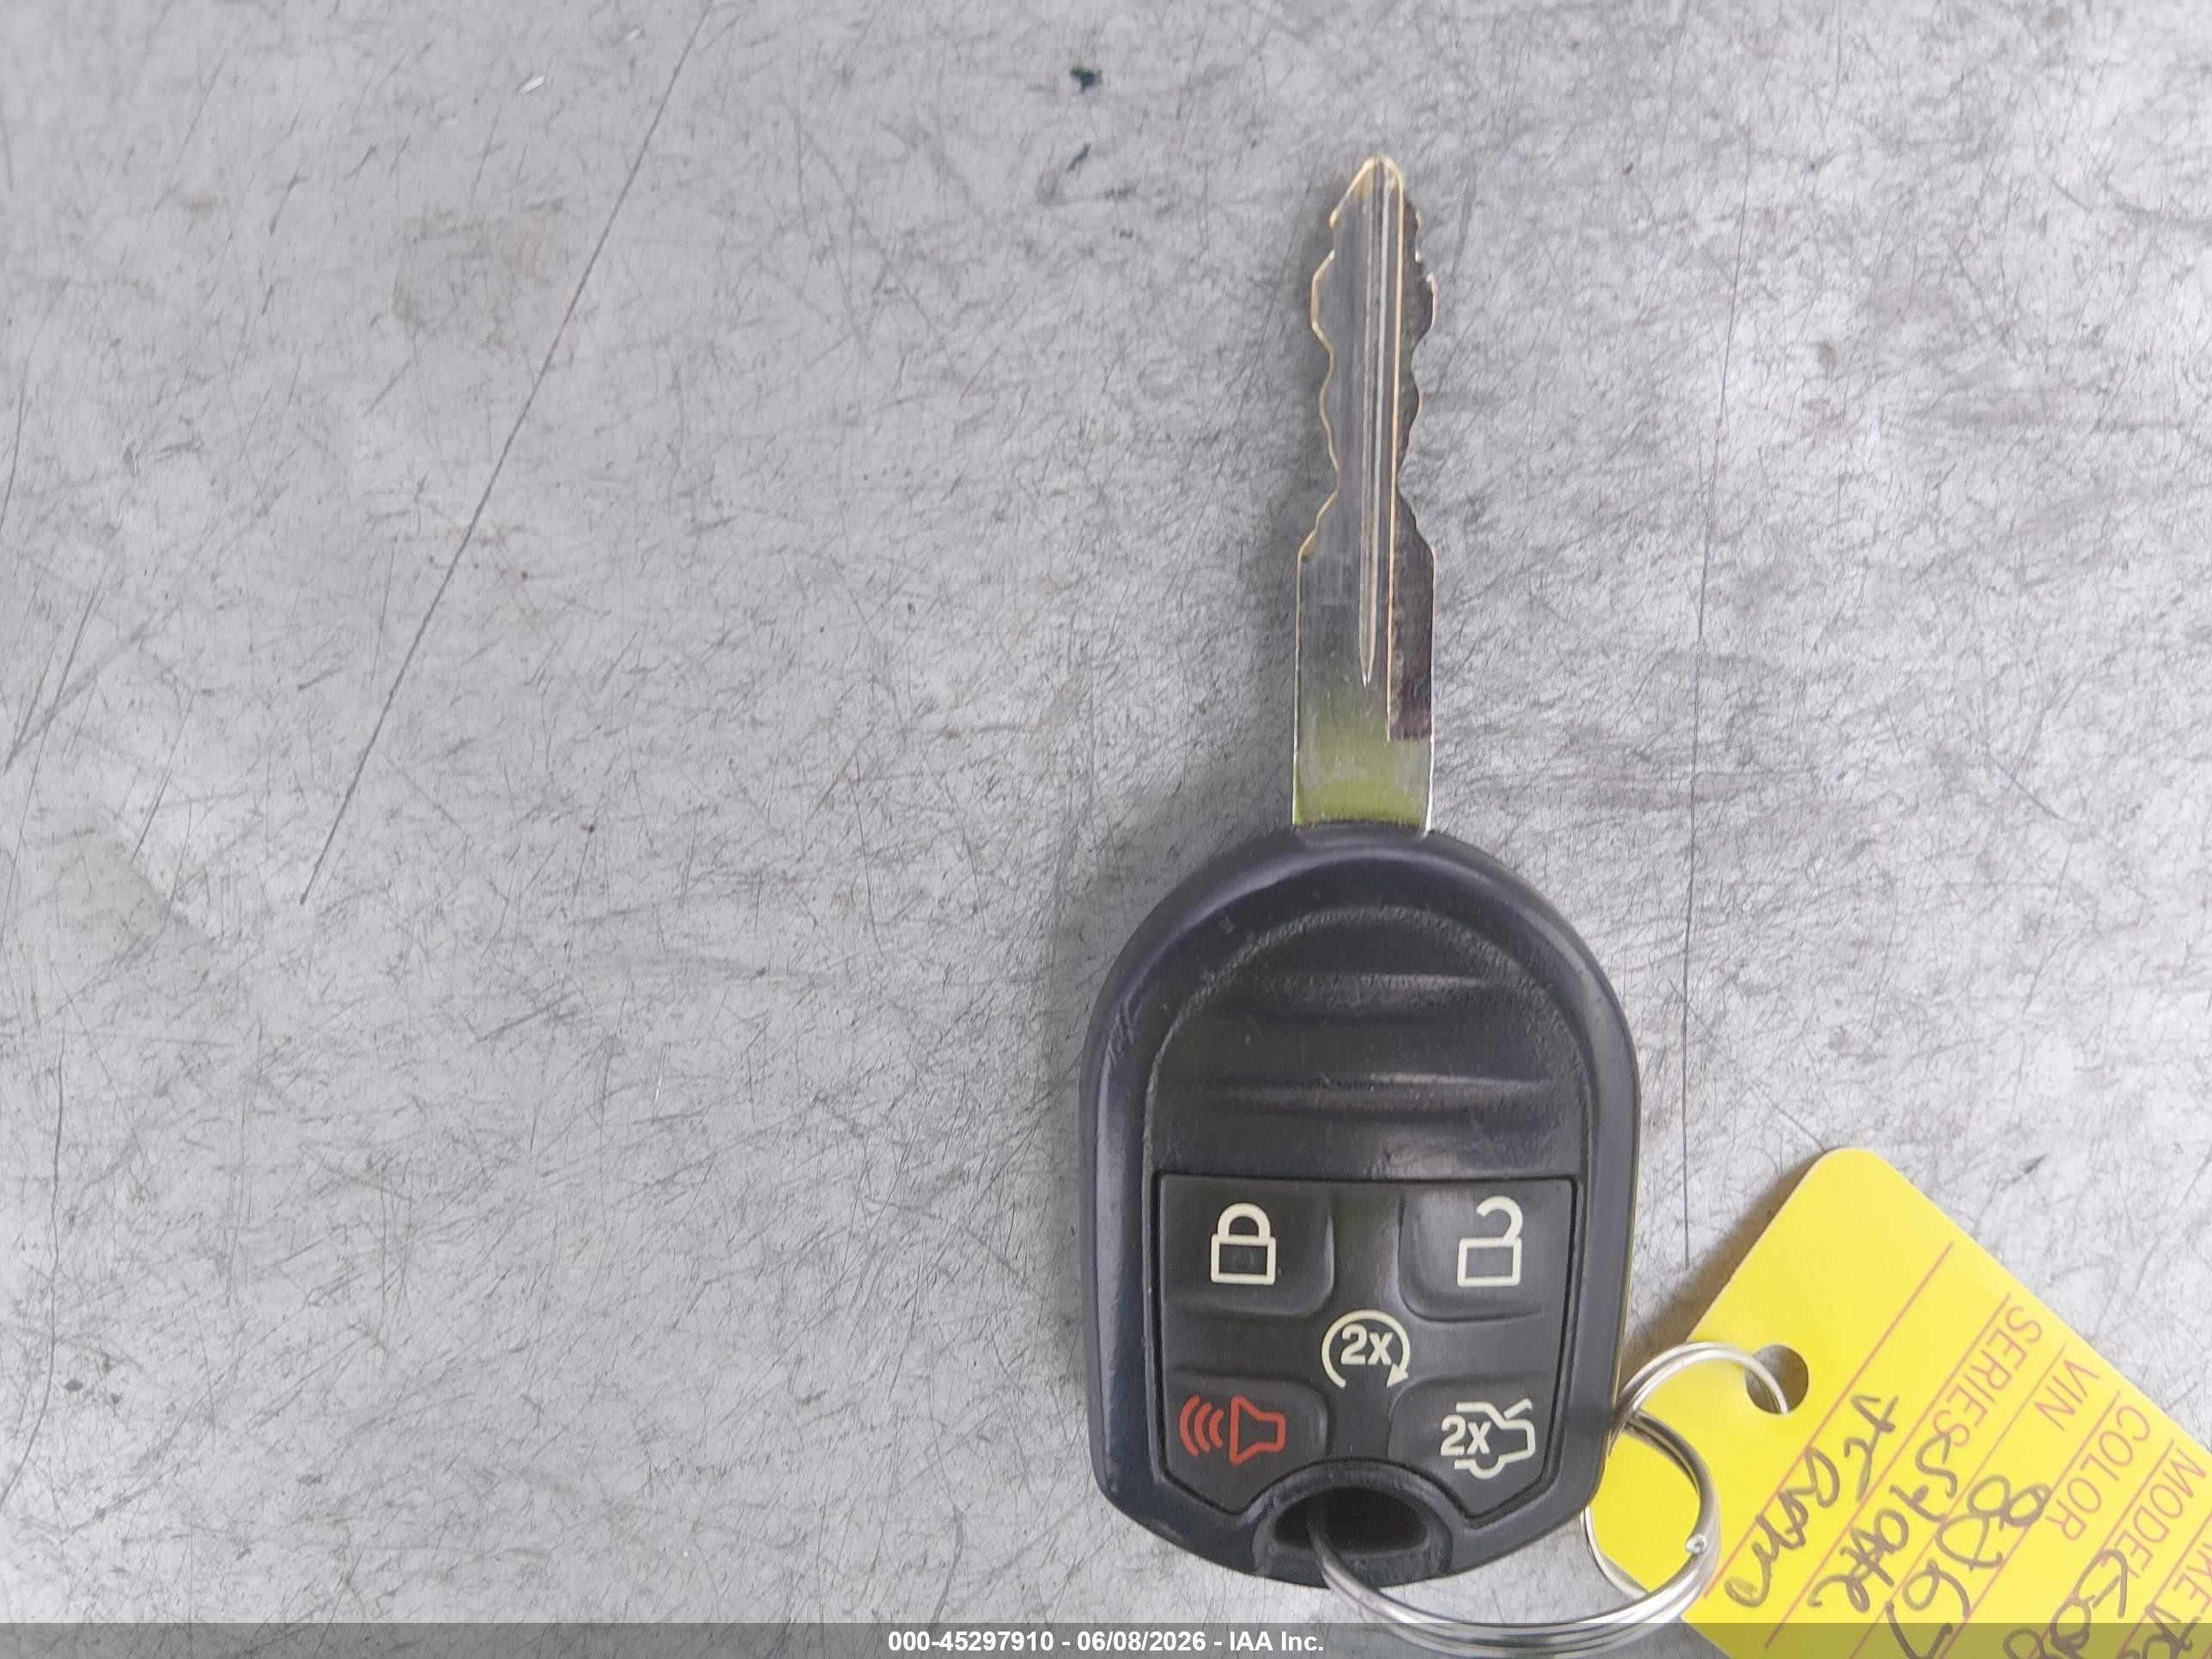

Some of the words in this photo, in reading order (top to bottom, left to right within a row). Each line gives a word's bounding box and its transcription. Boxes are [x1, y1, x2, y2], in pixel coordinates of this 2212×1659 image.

[1932, 1305, 2043, 1447] SERIES
[2033, 1359, 2100, 1432] VIN
[2045, 1405, 2151, 1540] COLOR
[2100, 1448, 2207, 1579] MODEL
